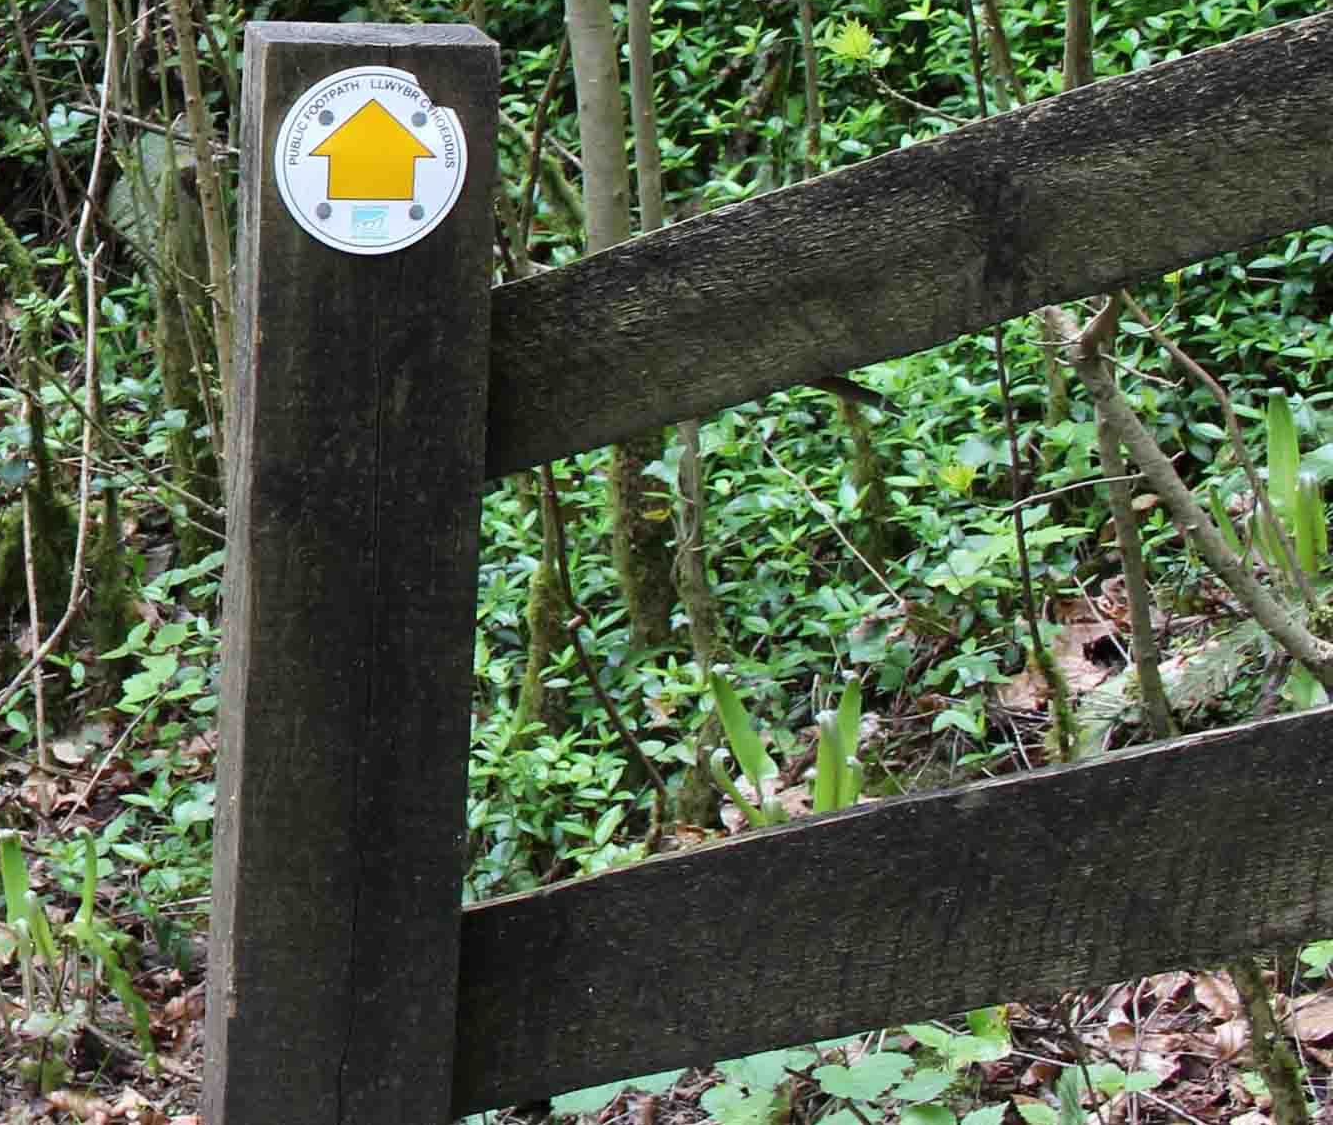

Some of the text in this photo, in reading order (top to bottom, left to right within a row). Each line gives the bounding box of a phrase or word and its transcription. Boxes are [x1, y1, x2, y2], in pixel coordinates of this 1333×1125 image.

[370, 79, 422, 100] LLWYBR
[289, 80, 360, 166] PUBLIC FOOTPATH
